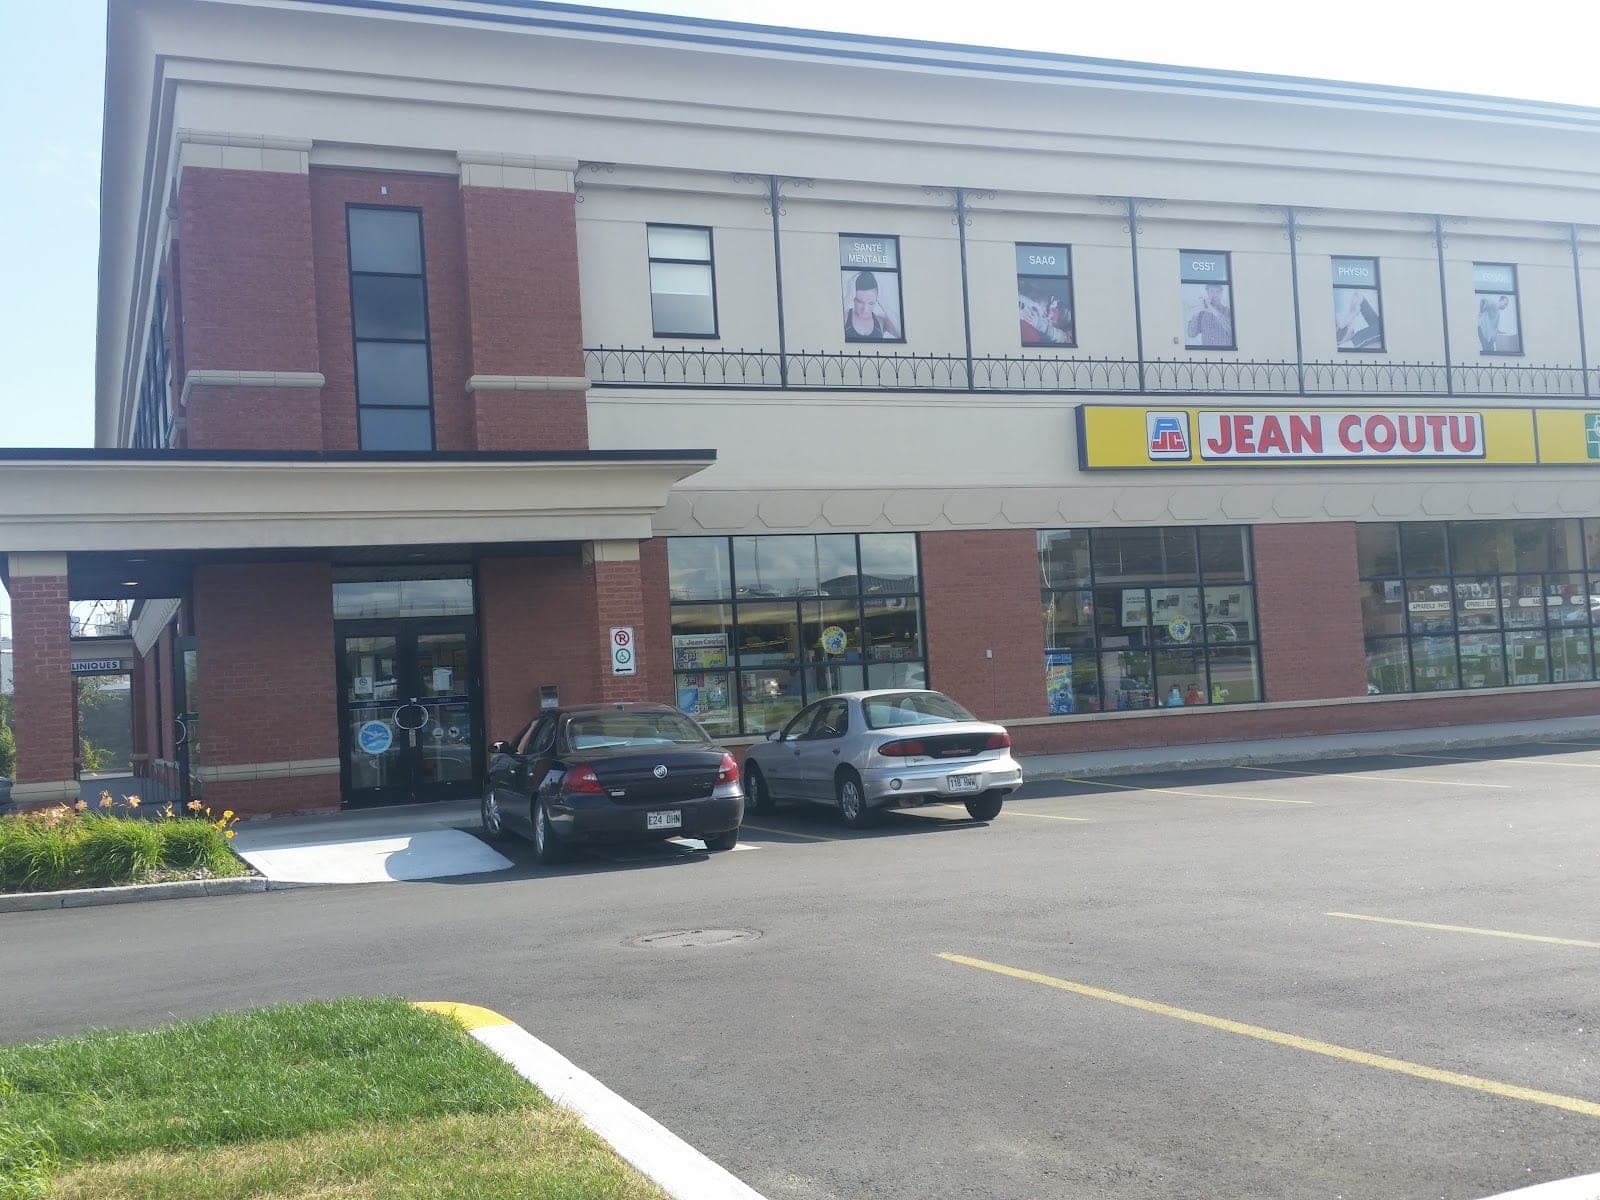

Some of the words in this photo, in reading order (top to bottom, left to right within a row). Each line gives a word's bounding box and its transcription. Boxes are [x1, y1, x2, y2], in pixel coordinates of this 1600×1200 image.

[854, 241, 882, 252] SANTÉ
[848, 254, 888, 264] MENTALE
[1029, 256, 1056, 265] SAAQ
[1192, 261, 1216, 271] CSST
[1338, 267, 1369, 277] PHYSIO
[1207, 414, 1323, 454] JEAN
[1338, 414, 1476, 453] COUTU
[71, 661, 117, 670] LINIQUES
[648, 815, 663, 825] E24
